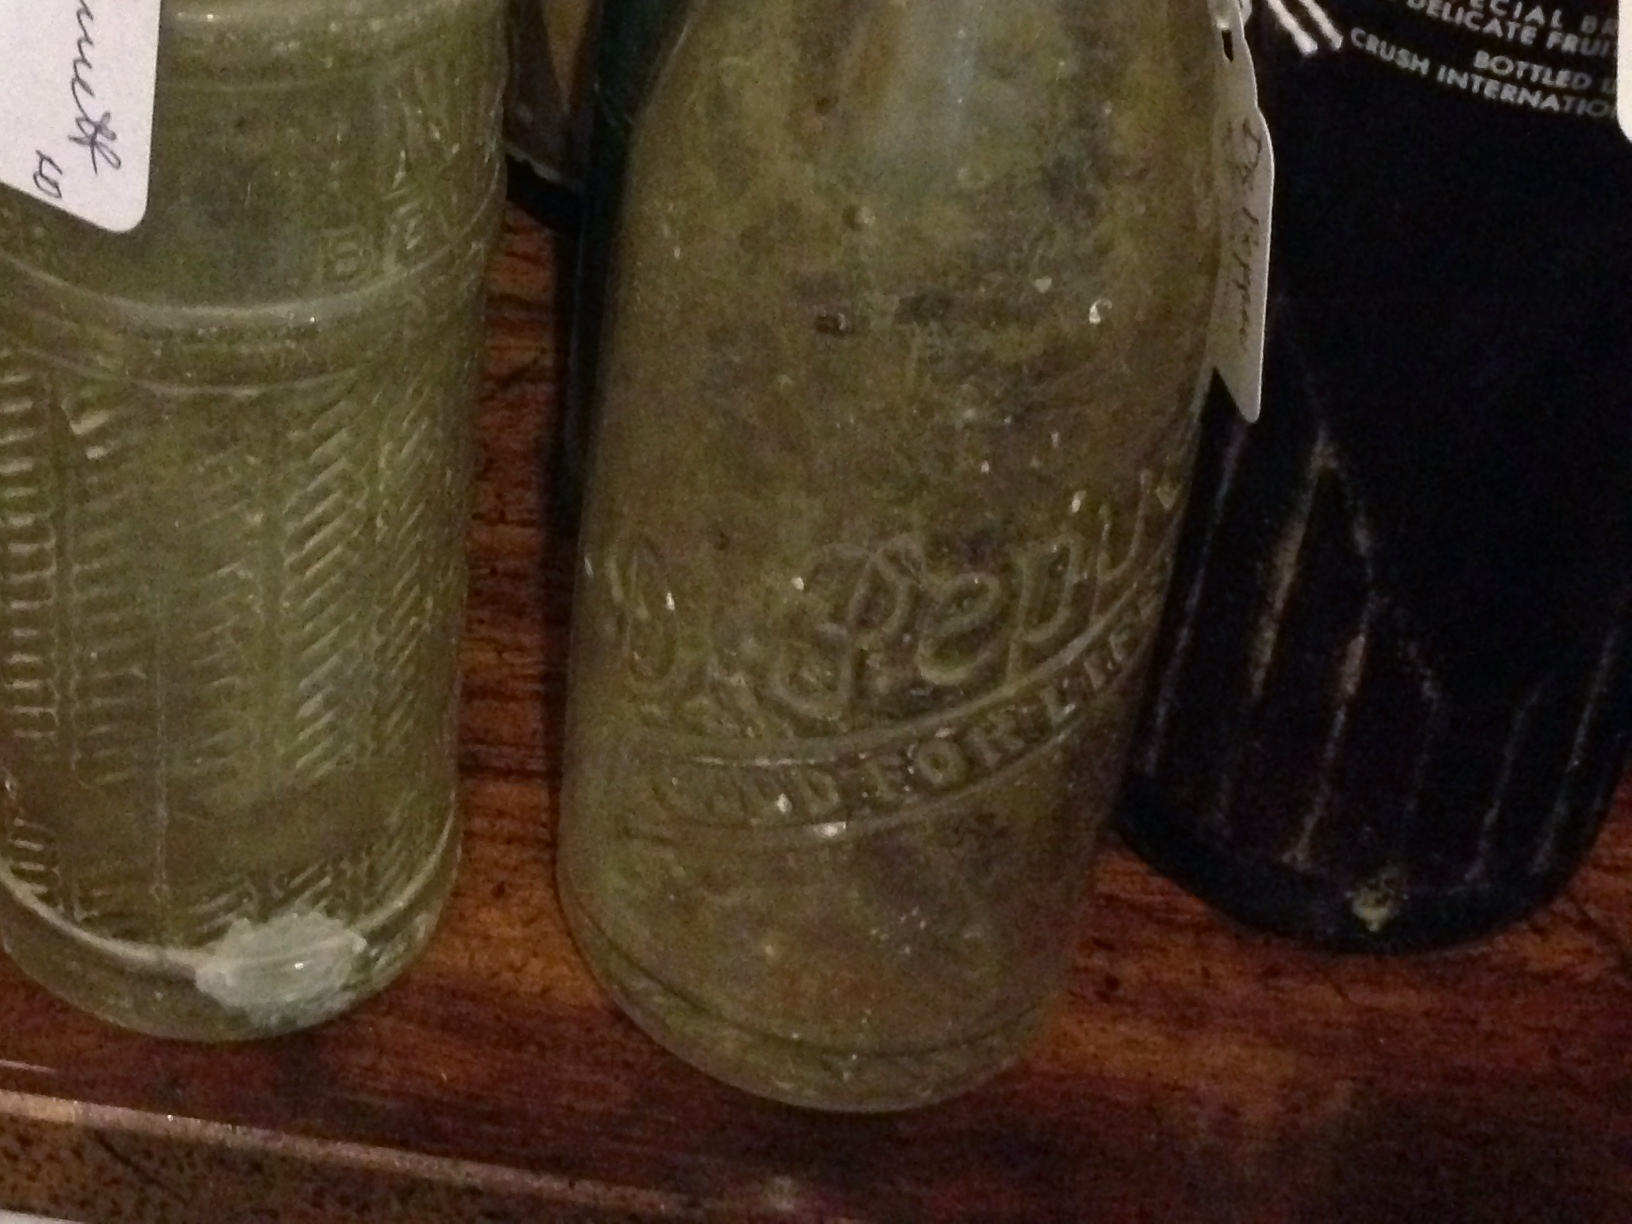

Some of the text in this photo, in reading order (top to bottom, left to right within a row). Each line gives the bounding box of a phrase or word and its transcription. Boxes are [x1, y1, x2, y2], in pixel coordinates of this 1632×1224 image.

[1350, 27, 1430, 75] CRUSH
[1547, 31, 1618, 58] FRUI
[1473, 50, 1592, 90] BOTTLED
